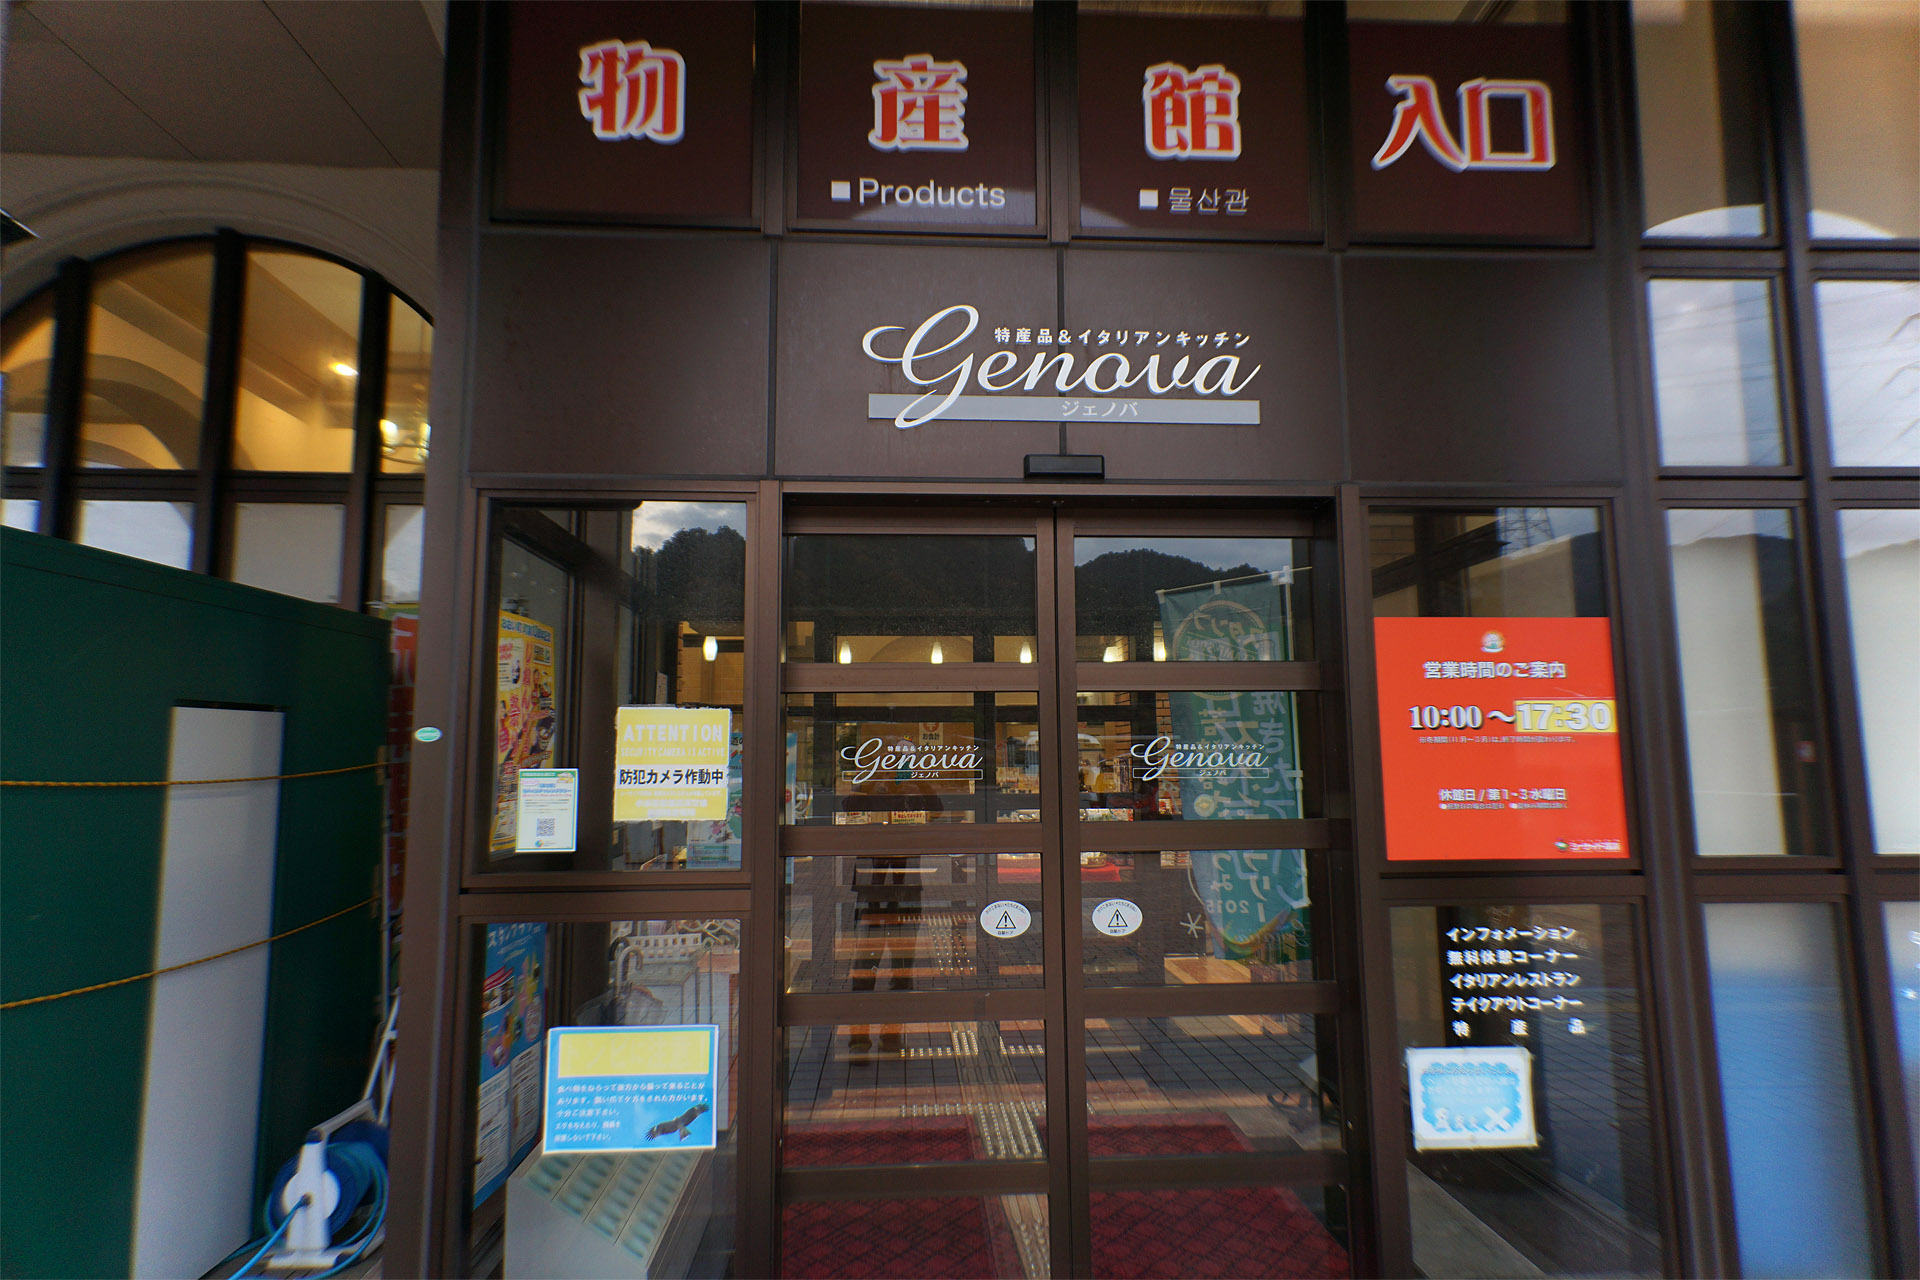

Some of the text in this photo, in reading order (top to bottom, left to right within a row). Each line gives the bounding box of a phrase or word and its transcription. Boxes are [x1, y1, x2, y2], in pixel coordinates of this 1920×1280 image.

[578, 39, 1558, 172] 物 産 館 入口
[858, 177, 1006, 207] Products
[1168, 187, 1250, 215] 물산관
[862, 304, 1262, 429] Genova
[1060, 400, 1139, 418] ジェノバ
[1423, 661, 1567, 679] 営業時間のご案内
[623, 724, 723, 742] ATTENTION
[620, 747, 726, 757] SECURITY CAMERA IS ACTIVE
[840, 737, 984, 784] Genova
[1130, 735, 1269, 781] Genova
[619, 768, 724, 785] 防犯カメラ作動中
[910, 771, 940, 779] ジェノバ
[1445, 925, 1577, 942] インフォメーション
[1446, 949, 1579, 965] 無料休憩コーナー
[1449, 971, 1581, 989] イタリアンレストラン
[1450, 995, 1584, 1013] テイクアウトコーナー
